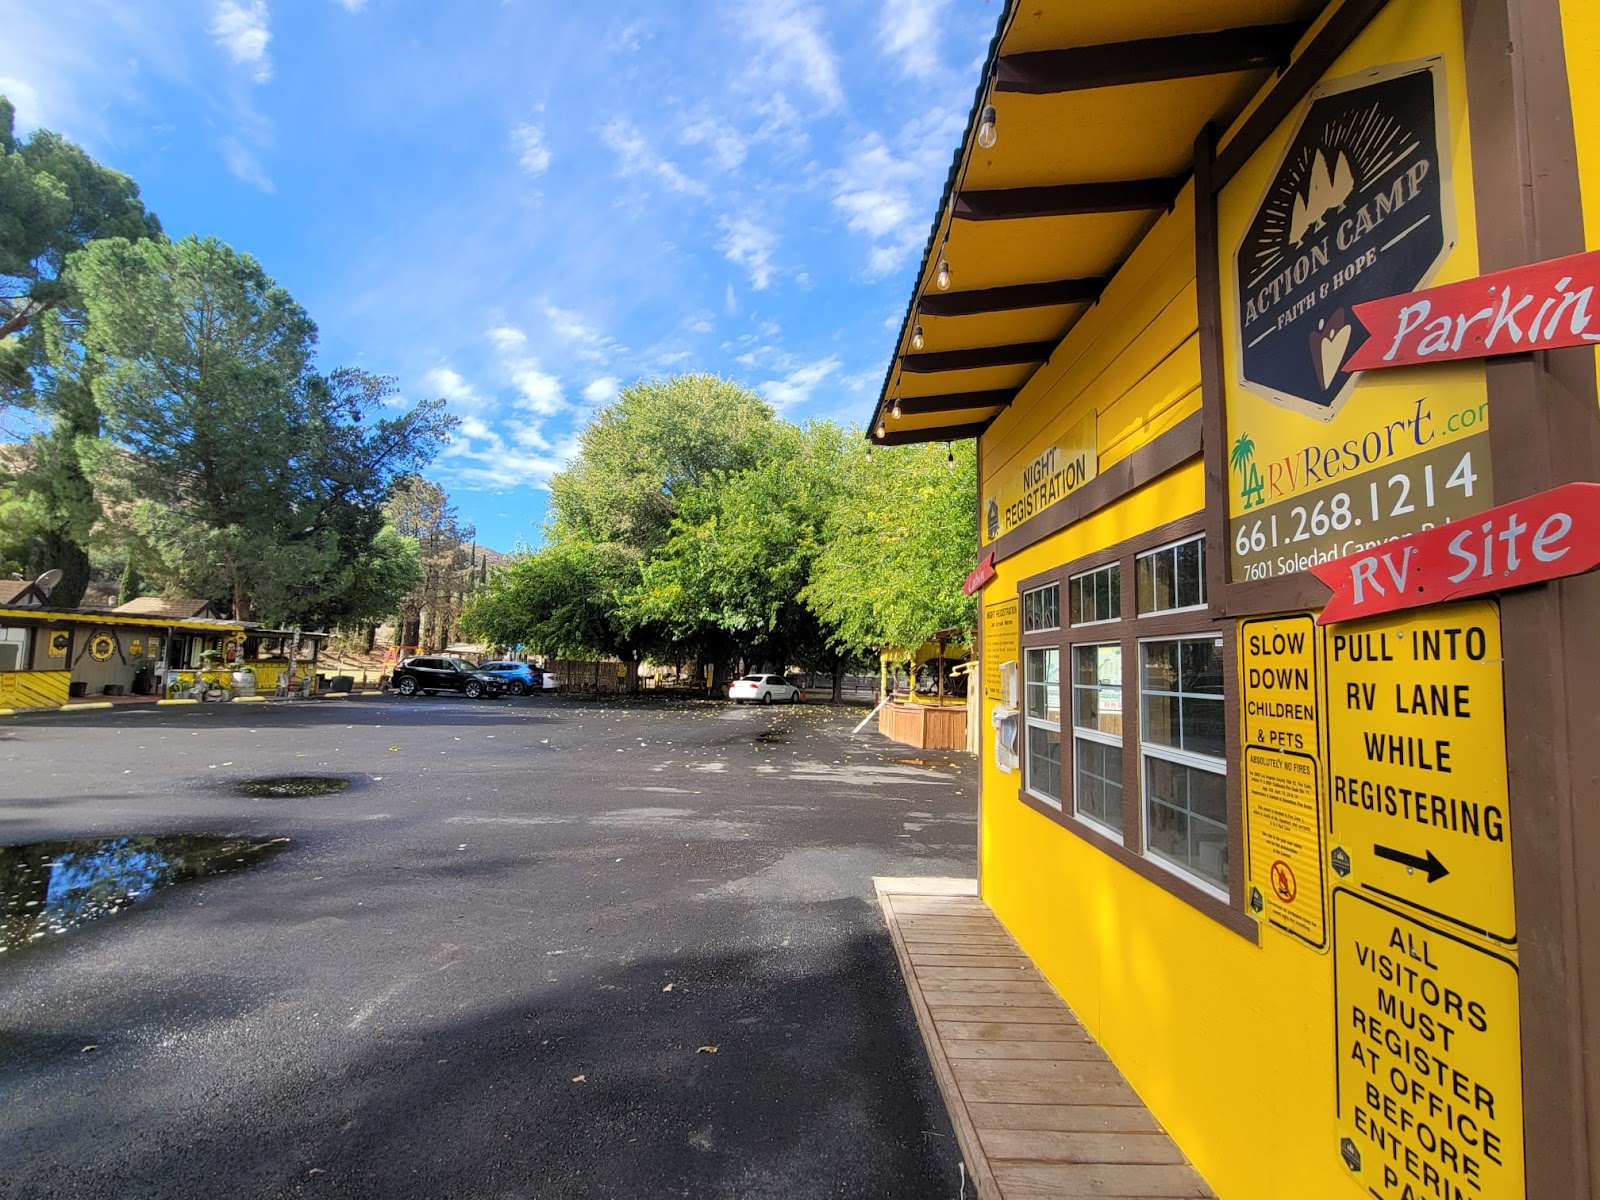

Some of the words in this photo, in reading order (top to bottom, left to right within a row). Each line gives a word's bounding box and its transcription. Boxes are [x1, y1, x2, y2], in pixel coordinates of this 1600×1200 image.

[1244, 236, 1331, 327] ACTION
[1336, 159, 1430, 251] CAMP
[1277, 292, 1316, 330] FAITH
[1319, 283, 1329, 300] &
[1333, 246, 1377, 291] HOPE
[1383, 276, 1600, 360] Parkin
[1005, 454, 1086, 530] REGISTRATION
[1023, 446, 1057, 493] NIGHT
[1235, 451, 1478, 556] 661.268.1214
[1243, 560, 1273, 582] 7601
[1277, 544, 1338, 576] Soledad
[1350, 545, 1414, 605] RV
[1448, 512, 1573, 584] Site
[1250, 632, 1305, 656] SLOW
[1334, 632, 1393, 661] PULL
[1413, 627, 1486, 661] INTO
[1247, 701, 1314, 721] CHILDREN
[1249, 668, 1309, 691] DOWN
[1347, 682, 1376, 710] RV
[1396, 683, 1471, 718] LANE
[1250, 755, 1283, 769] ABSOLUTELY
[1284, 761, 1293, 771] NO
[1294, 763, 1311, 775] FIRES
[1257, 728, 1265, 743] &
[1270, 730, 1304, 749] PETS
[1364, 732, 1452, 773] WHILE
[1335, 775, 1503, 842] REGISTERING
[1389, 926, 1438, 971] ALL
[1355, 941, 1487, 1032] VISITORS
[1378, 987, 1454, 1052] MUST
[1352, 1005, 1495, 1120] REGISTER
[1351, 1040, 1380, 1075] AT
[1390, 1067, 1502, 1166] OFFICE
[1366, 1081, 1481, 1191] BEFORE
